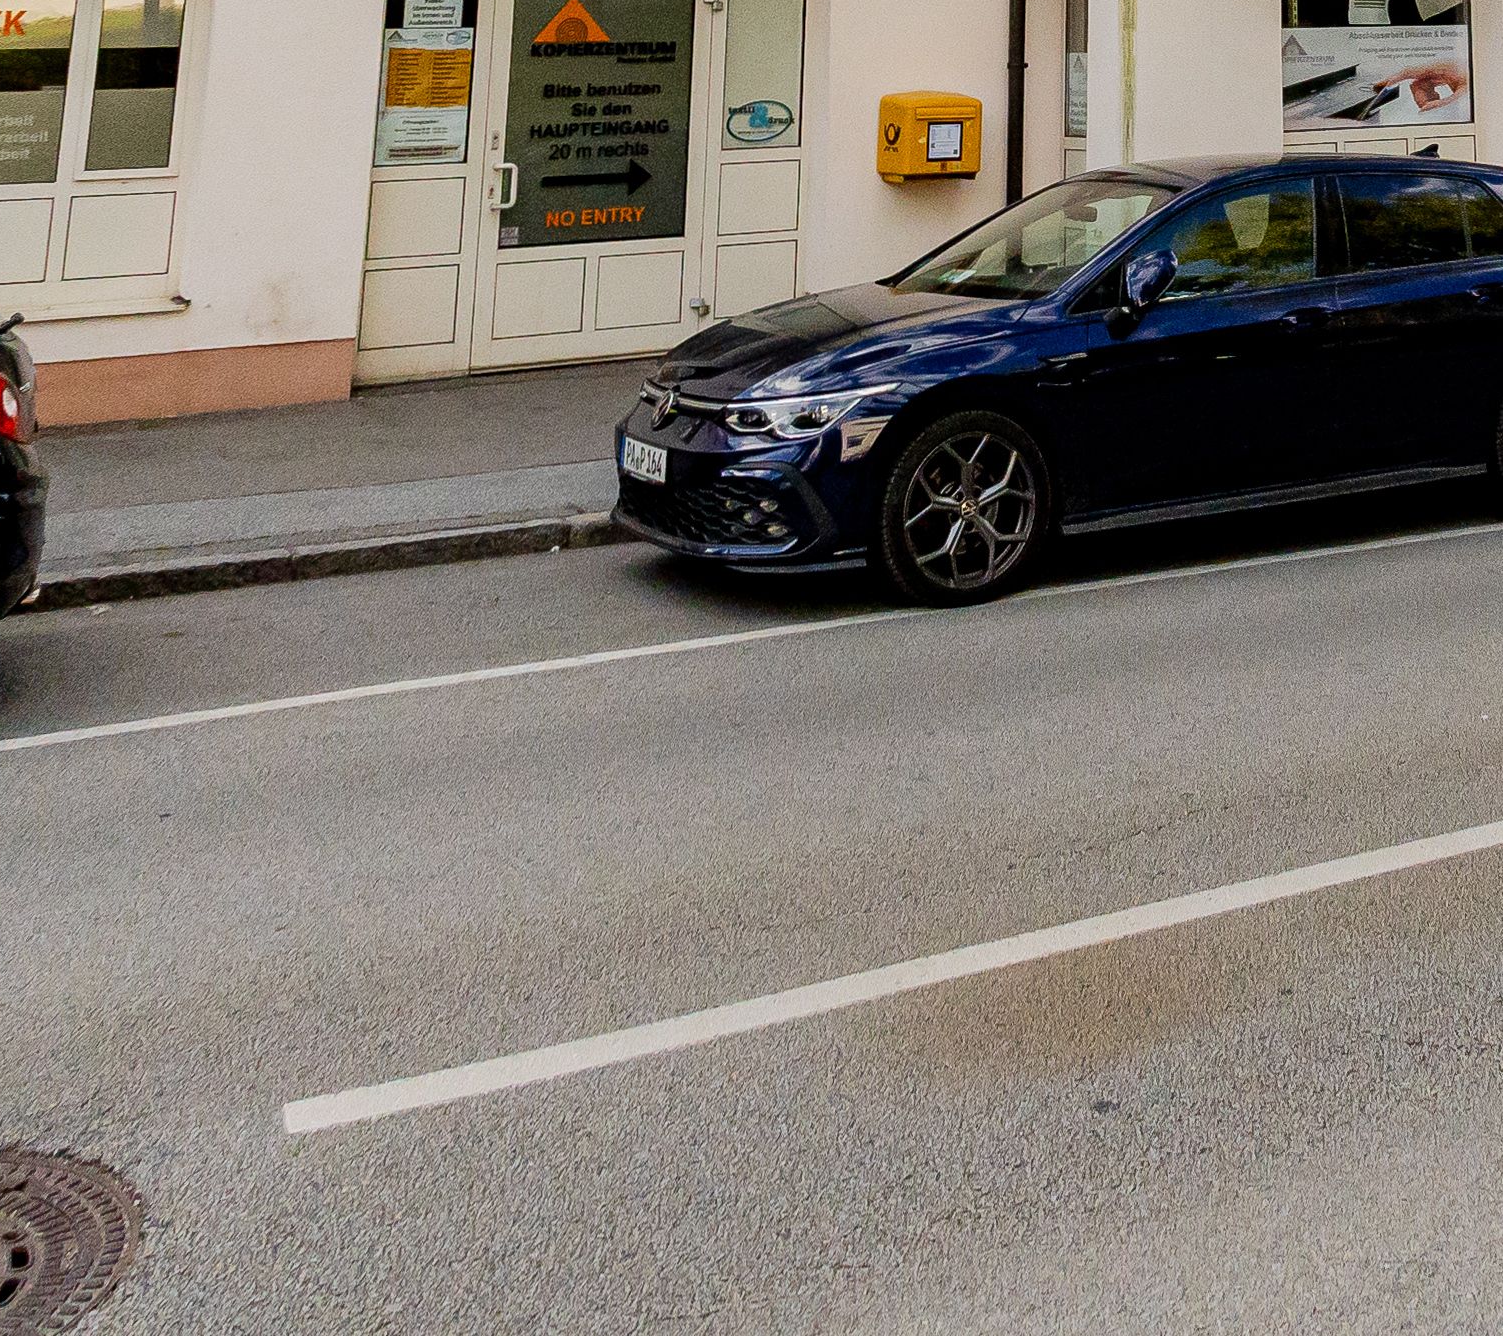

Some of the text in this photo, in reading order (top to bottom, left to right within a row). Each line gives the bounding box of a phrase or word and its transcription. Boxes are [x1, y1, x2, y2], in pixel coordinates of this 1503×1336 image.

[530, 41, 677, 58] KOPIERZENTRUM
[543, 82, 662, 99] Bitte benutzen
[571, 101, 632, 118] Sie den
[530, 119, 670, 139] HAUPTEINGANG
[549, 143, 649, 161] 20 m rechts
[545, 204, 646, 229] NO ENTRY
